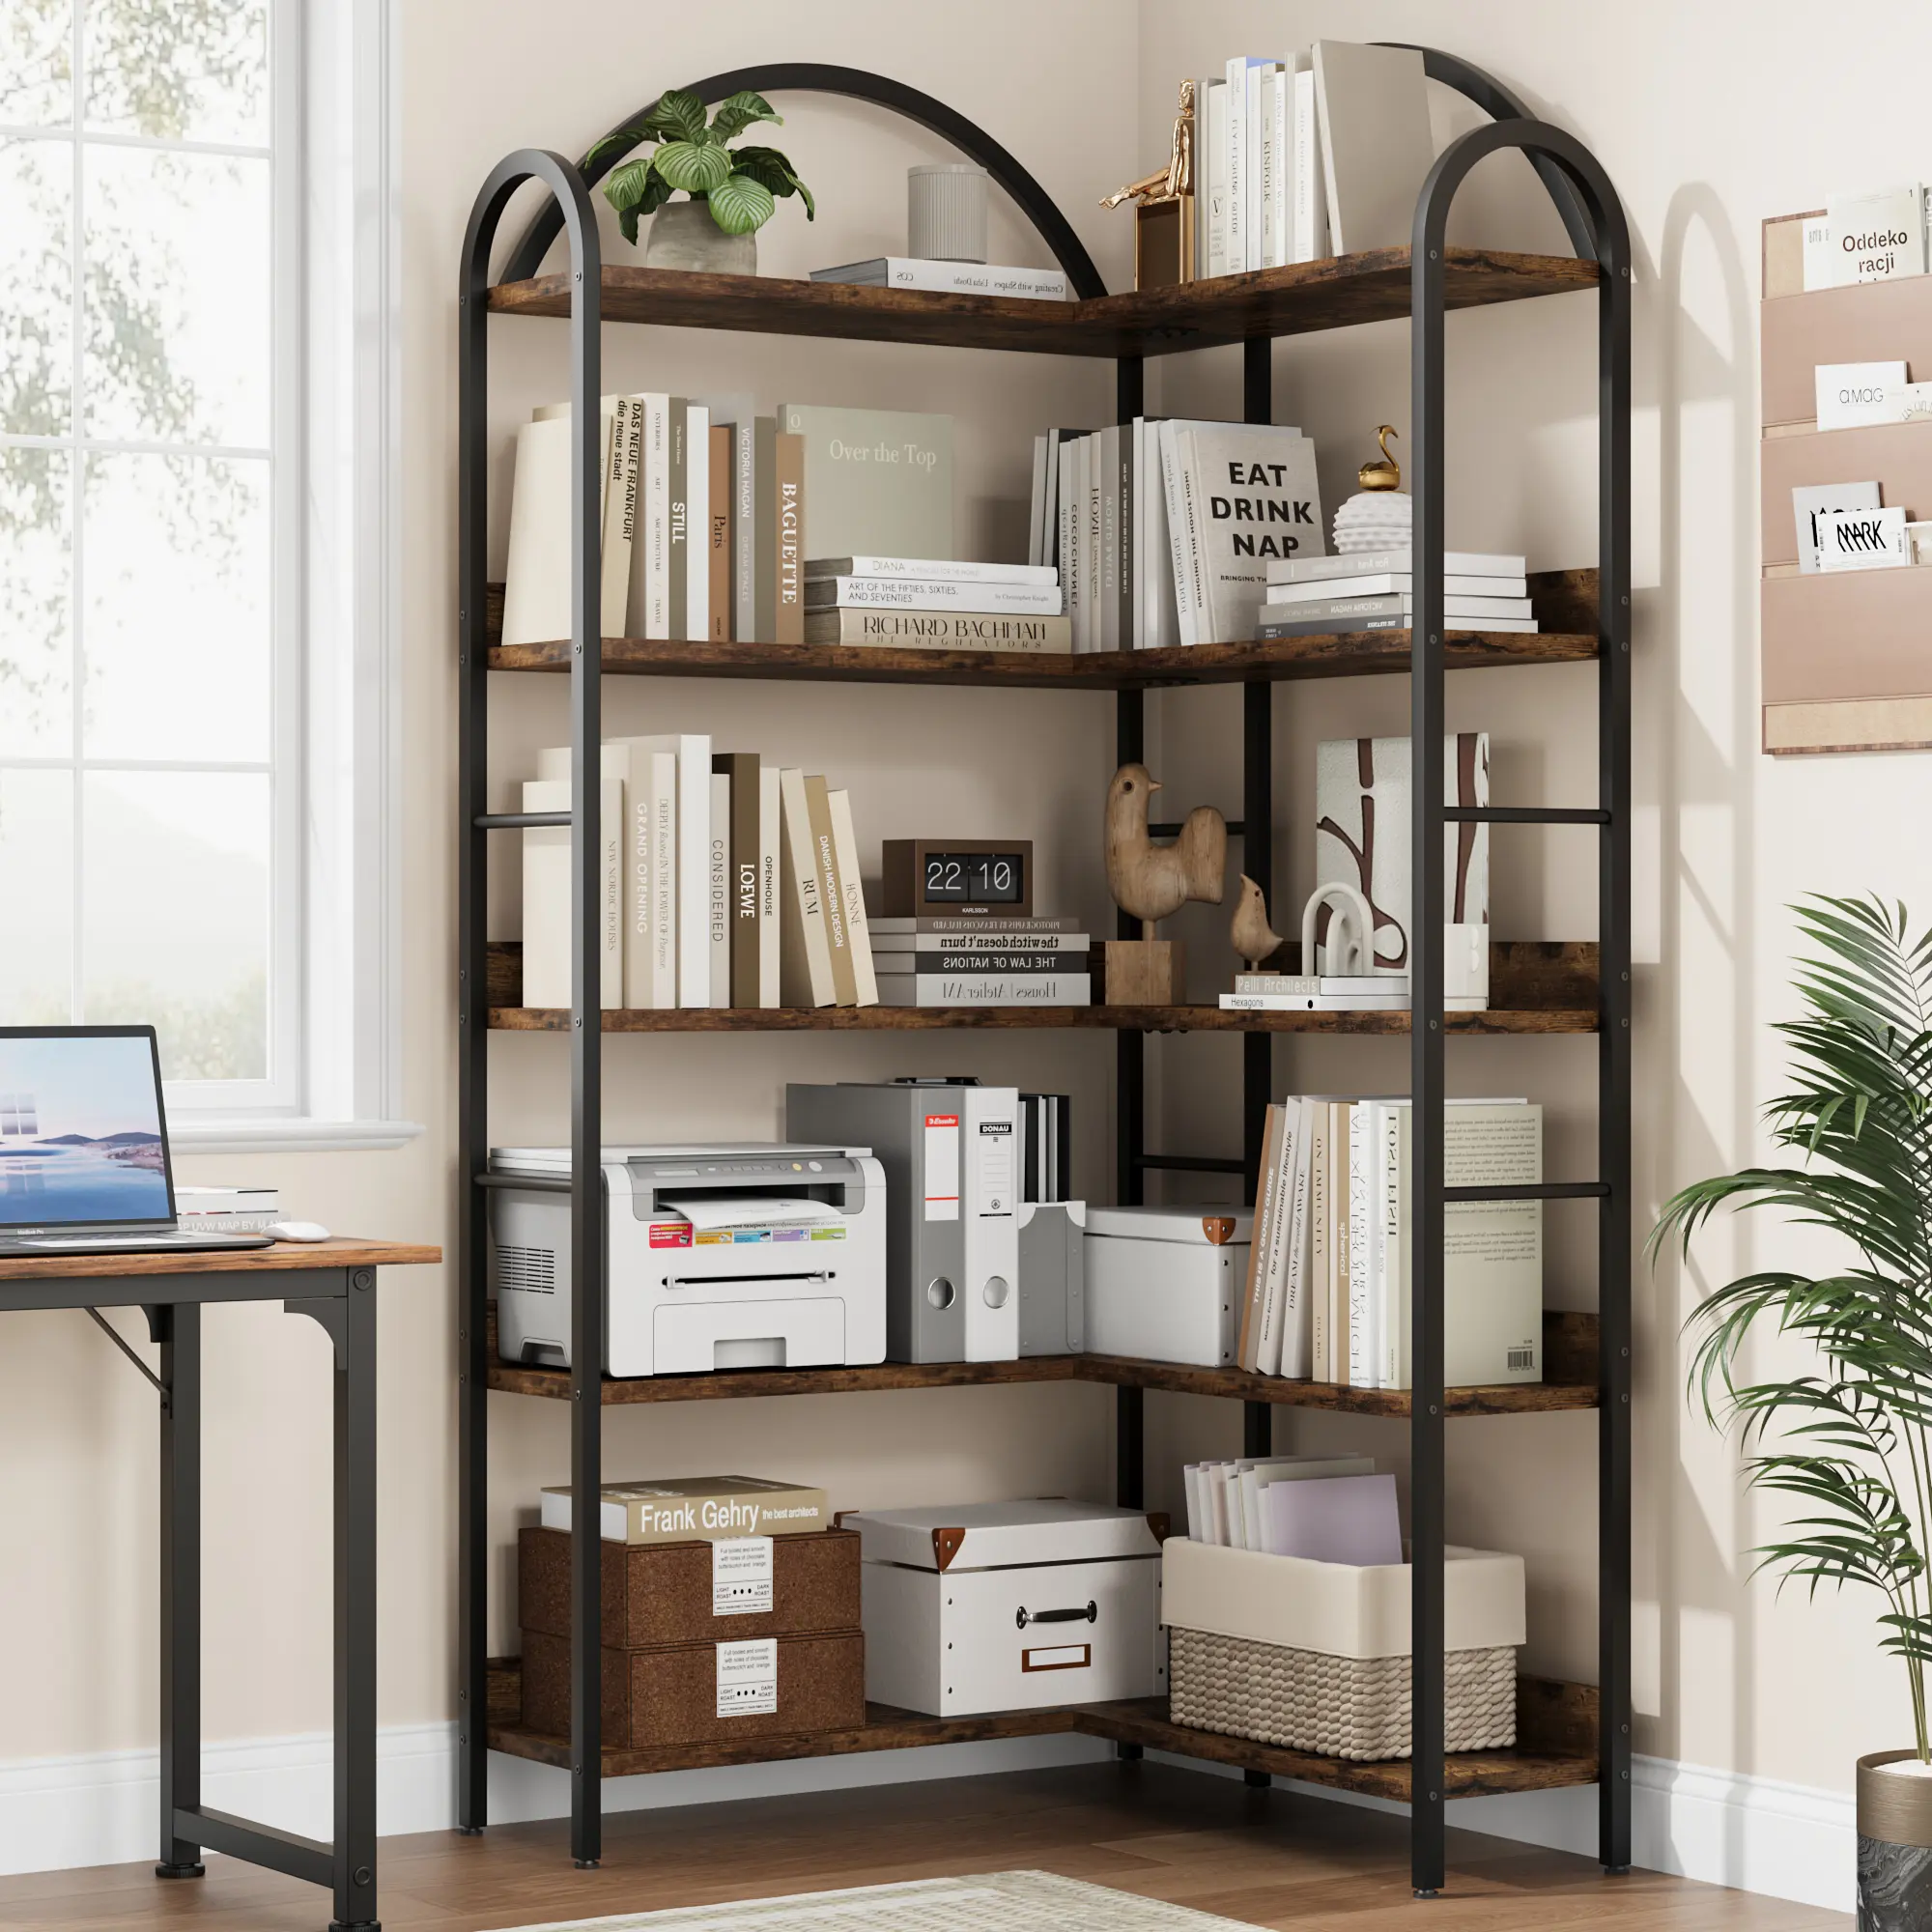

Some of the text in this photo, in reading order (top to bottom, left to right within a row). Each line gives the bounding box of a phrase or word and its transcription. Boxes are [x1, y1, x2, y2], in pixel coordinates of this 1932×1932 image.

[1842, 229, 1909, 252] Oddeko
[1859, 252, 1895, 274] racji
[612, 400, 628, 481] die neue stadt
[829, 439, 937, 473] Over the Top
[622, 403, 641, 542] DAS NEUE FRANKFURT
[741, 427, 751, 518] VICTORIA HAGAN
[1228, 462, 1288, 487] EAT
[672, 501, 686, 545] STILL
[1210, 497, 1315, 525] DRINK
[714, 515, 726, 549] Paris
[781, 482, 797, 604] BAGUETTE
[1232, 533, 1299, 558] NAP
[1836, 520, 1887, 553] MARK
[872, 560, 905, 572] DIANA
[848, 582, 959, 596] ART OF THE FIFTIES, SIXTIES,
[870, 593, 913, 603] SEVENTIES
[1194, 559, 1203, 609] BRINGING
[863, 615, 1046, 640] RICHARD BACHMAN
[659, 798, 668, 830] DEEPLY
[637, 803, 648, 934] GRAND OPENING
[659, 870, 668, 889] THE
[927, 862, 1011, 891] 22 10
[608, 840, 616, 952] NEW NORDIC HOUSES
[712, 838, 724, 943] CONSIDERED
[740, 864, 755, 919] LOEWE
[764, 856, 773, 917] OPENHOUSE
[803, 879, 819, 915] RUM
[819, 835, 844, 948] DANISH MODERN DESIGN
[659, 890, 668, 922] POWER
[846, 883, 861, 926] HONNE
[659, 923, 668, 934] OF
[1231, 998, 1264, 1009] Hexagons
[1316, 1138, 1321, 1159] ON
[1265, 1166, 1274, 1207] GUIDE
[1275, 1179, 1287, 1246] sustainable
[1283, 1131, 1293, 1177] lifestyle
[217, 1221, 240, 1231] MAP
[242, 1220, 255, 1230] BY
[1260, 1209, 1269, 1247] GOOD
[1338, 1221, 1349, 1276] spherical
[1258, 1262, 1264, 1275] IS
[640, 1498, 818, 1533] Frank Gehry the best architects
